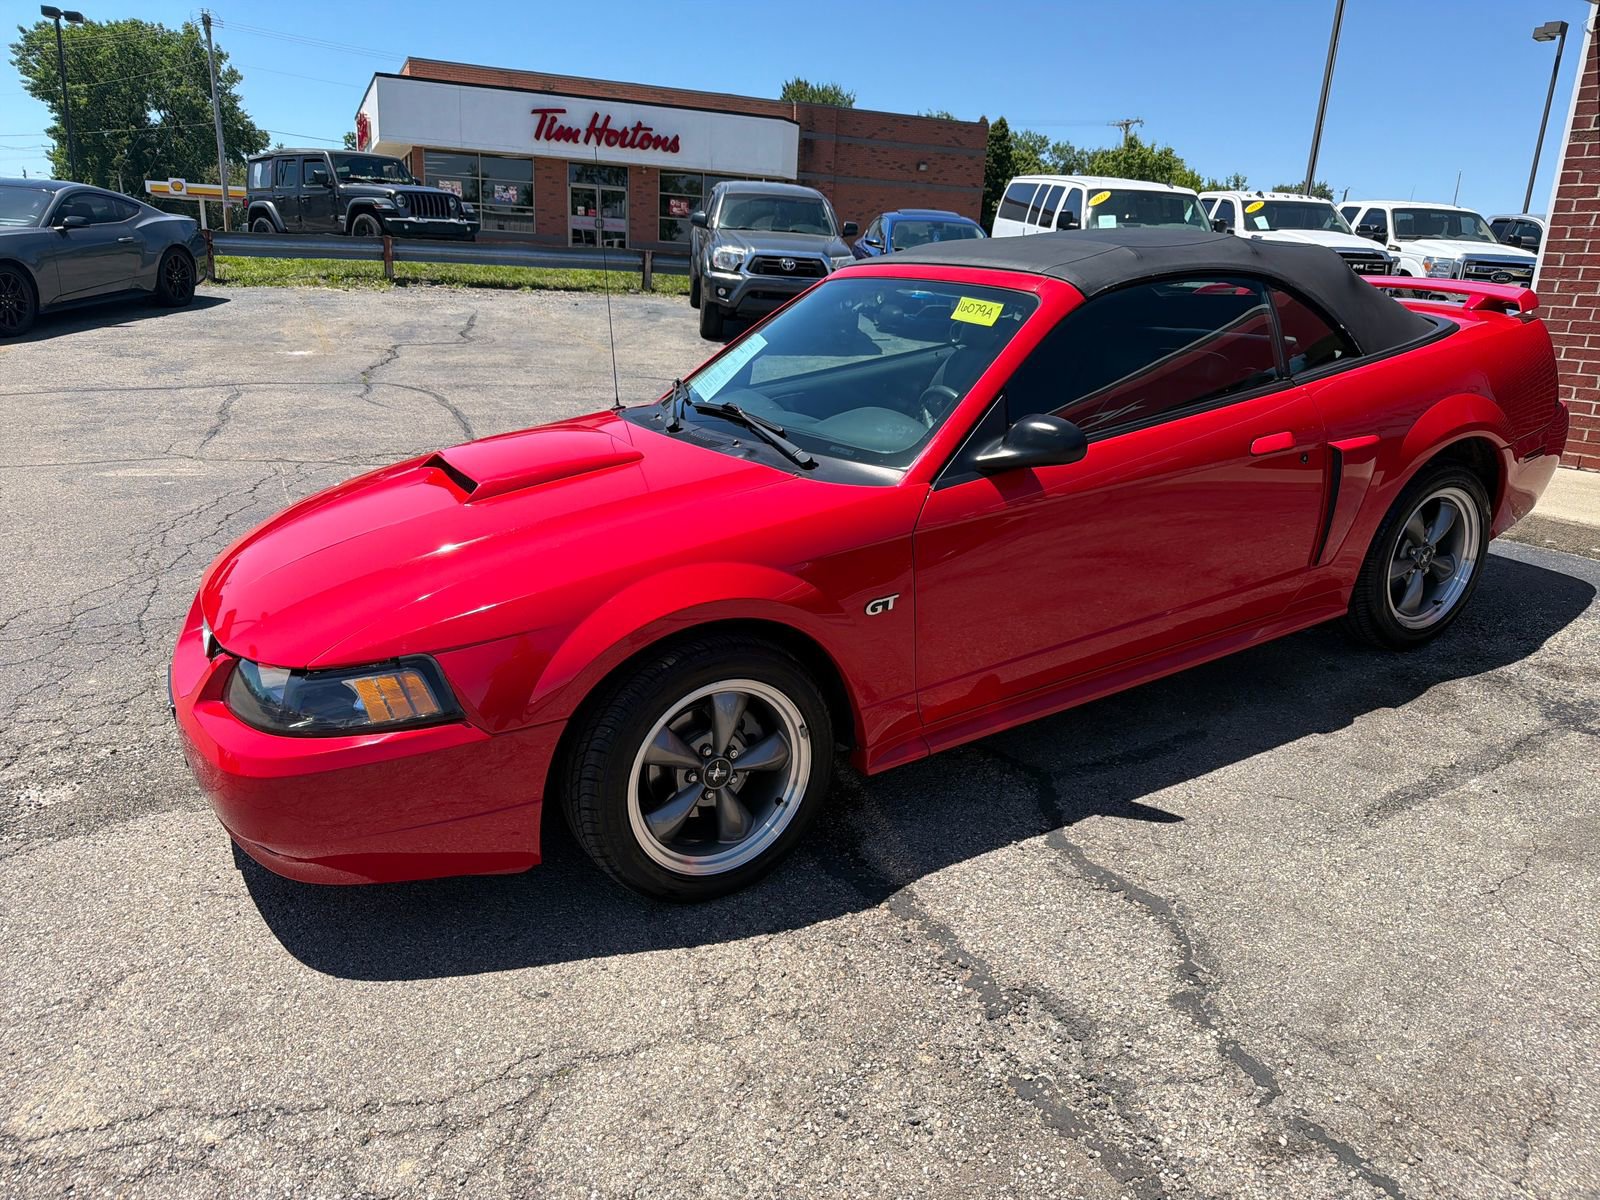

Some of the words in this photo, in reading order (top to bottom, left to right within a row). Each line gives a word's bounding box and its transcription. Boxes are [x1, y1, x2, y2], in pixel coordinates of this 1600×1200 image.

[531, 108, 581, 144] Tim
[584, 112, 681, 154] Hortons
[865, 593, 900, 616] GT
